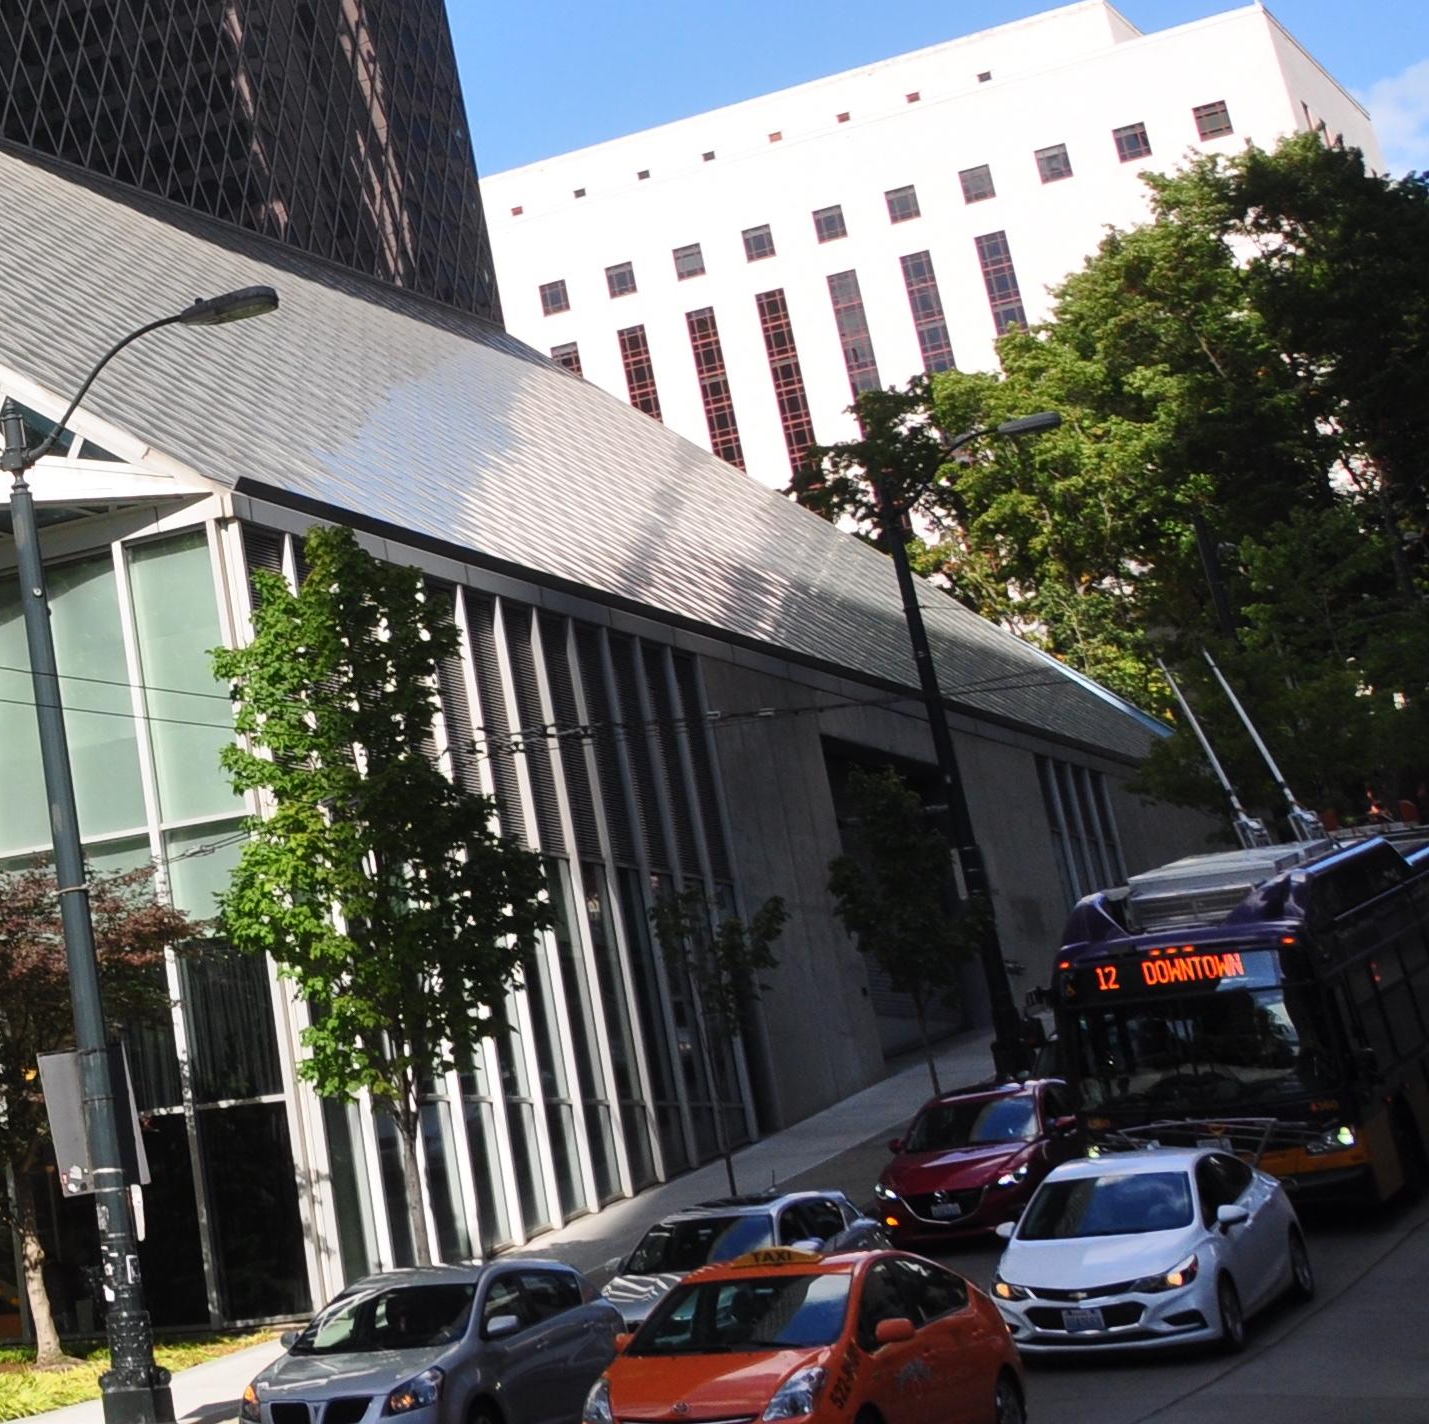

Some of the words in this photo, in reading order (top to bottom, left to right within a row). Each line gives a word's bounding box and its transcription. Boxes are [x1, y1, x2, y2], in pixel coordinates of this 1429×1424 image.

[1095, 965, 1120, 991] 12
[1141, 953, 1245, 986] DOWNTOWN
[752, 1250, 791, 1263] TAXI
